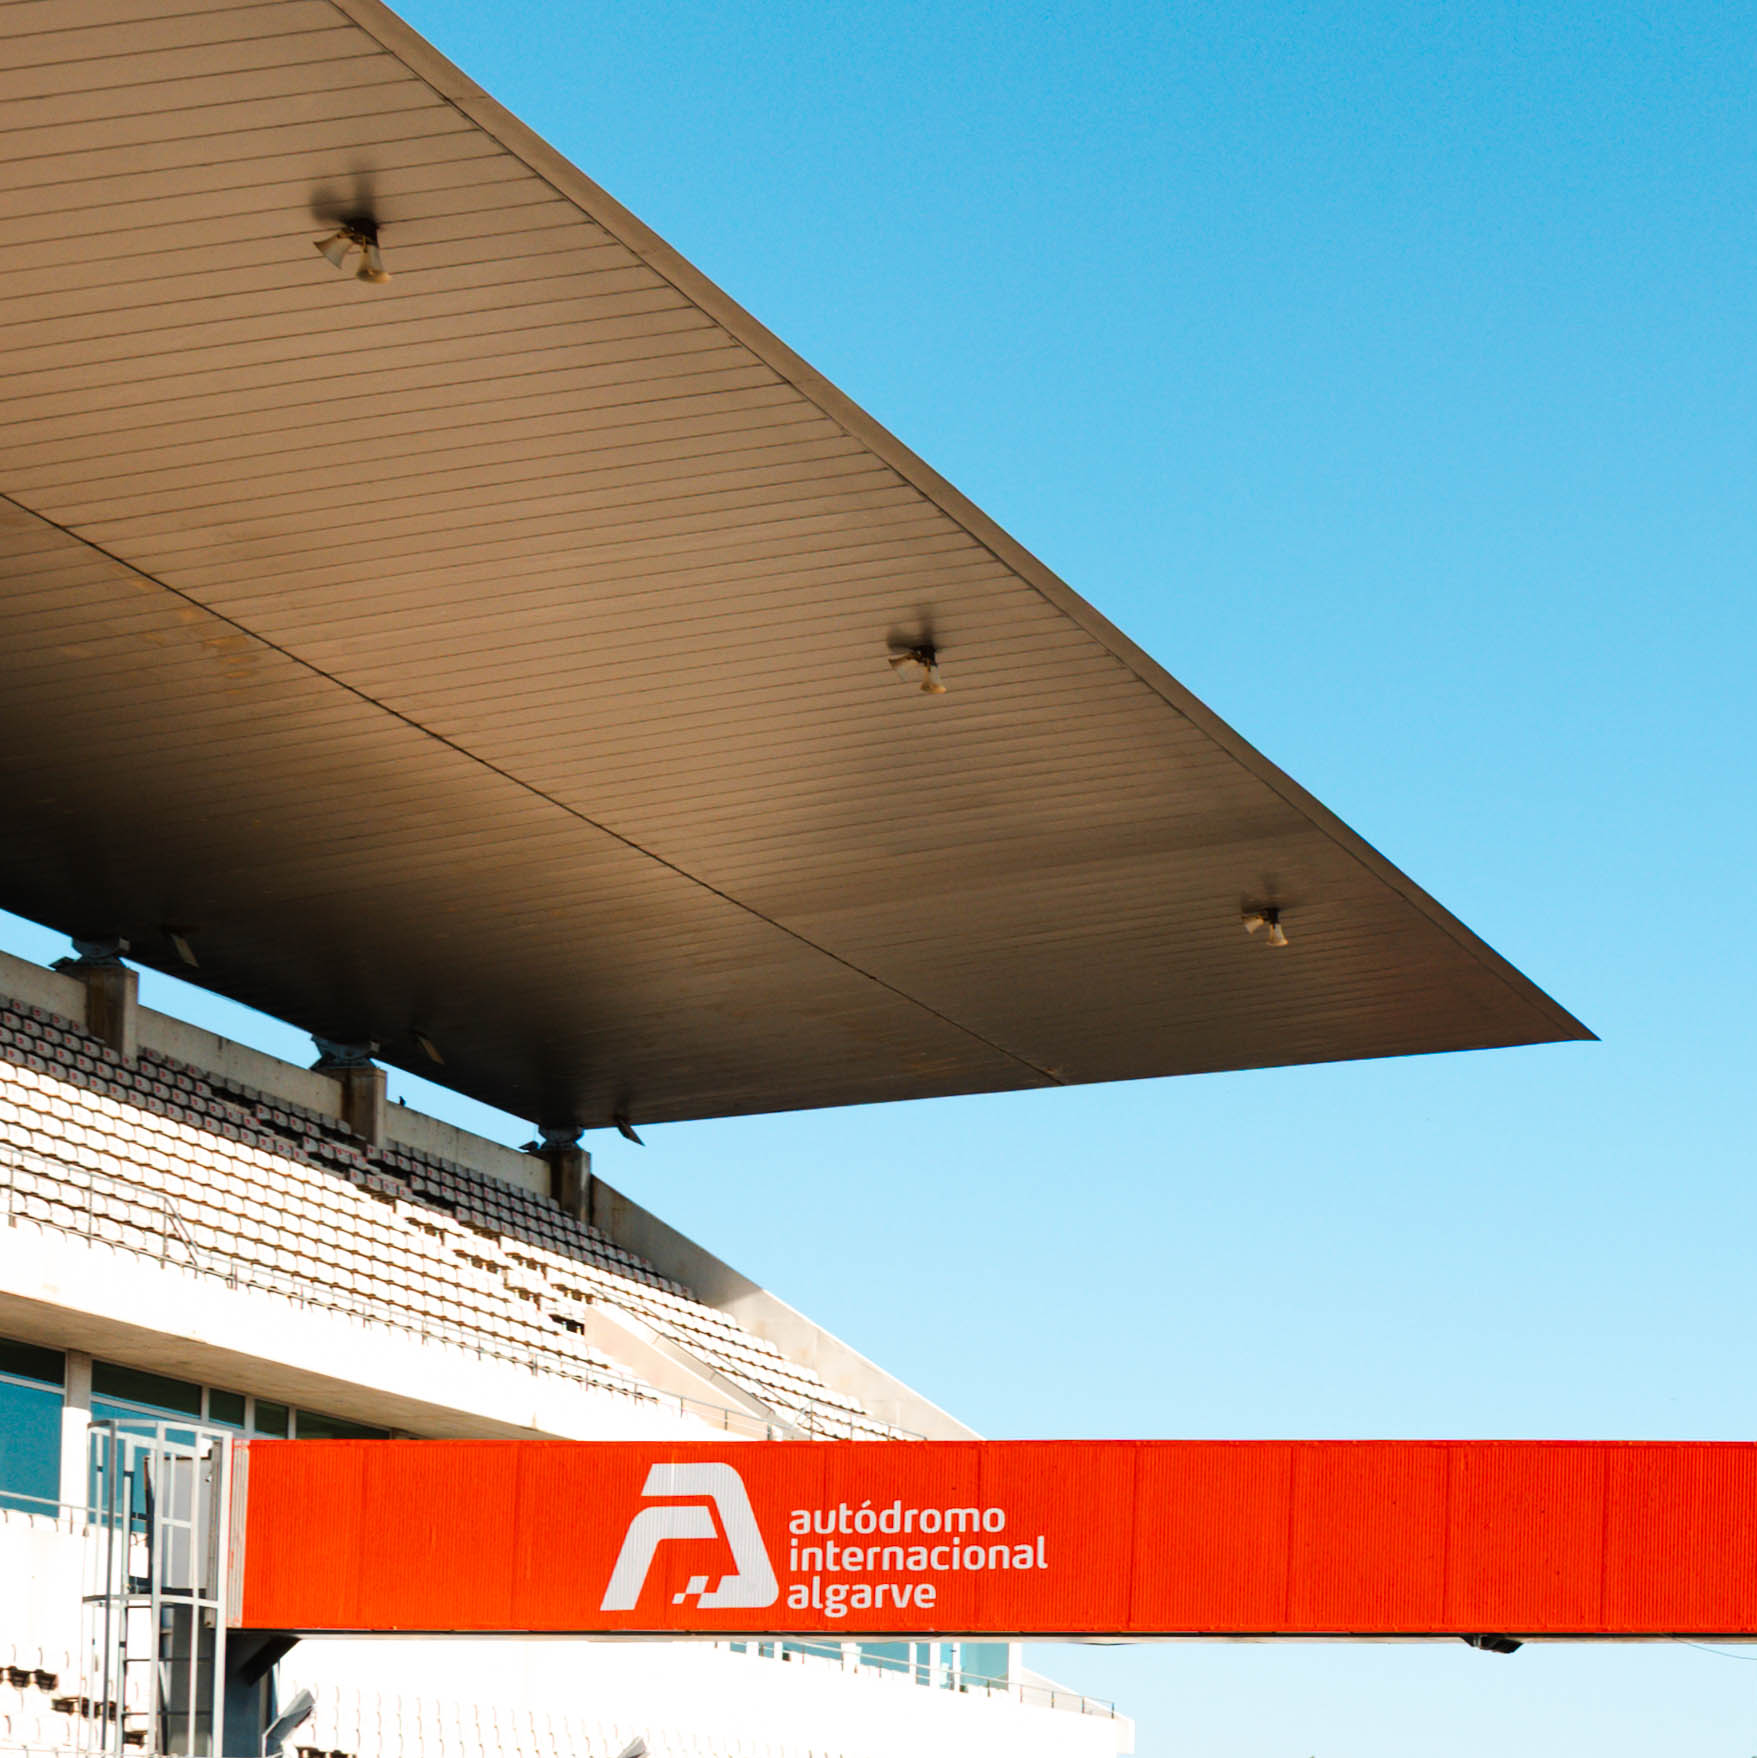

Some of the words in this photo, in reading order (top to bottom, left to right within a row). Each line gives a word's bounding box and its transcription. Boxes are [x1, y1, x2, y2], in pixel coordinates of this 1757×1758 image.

[789, 1499, 1006, 1535] autódromo
[790, 1535, 1049, 1572] internacional
[787, 1575, 937, 1619] algarve
